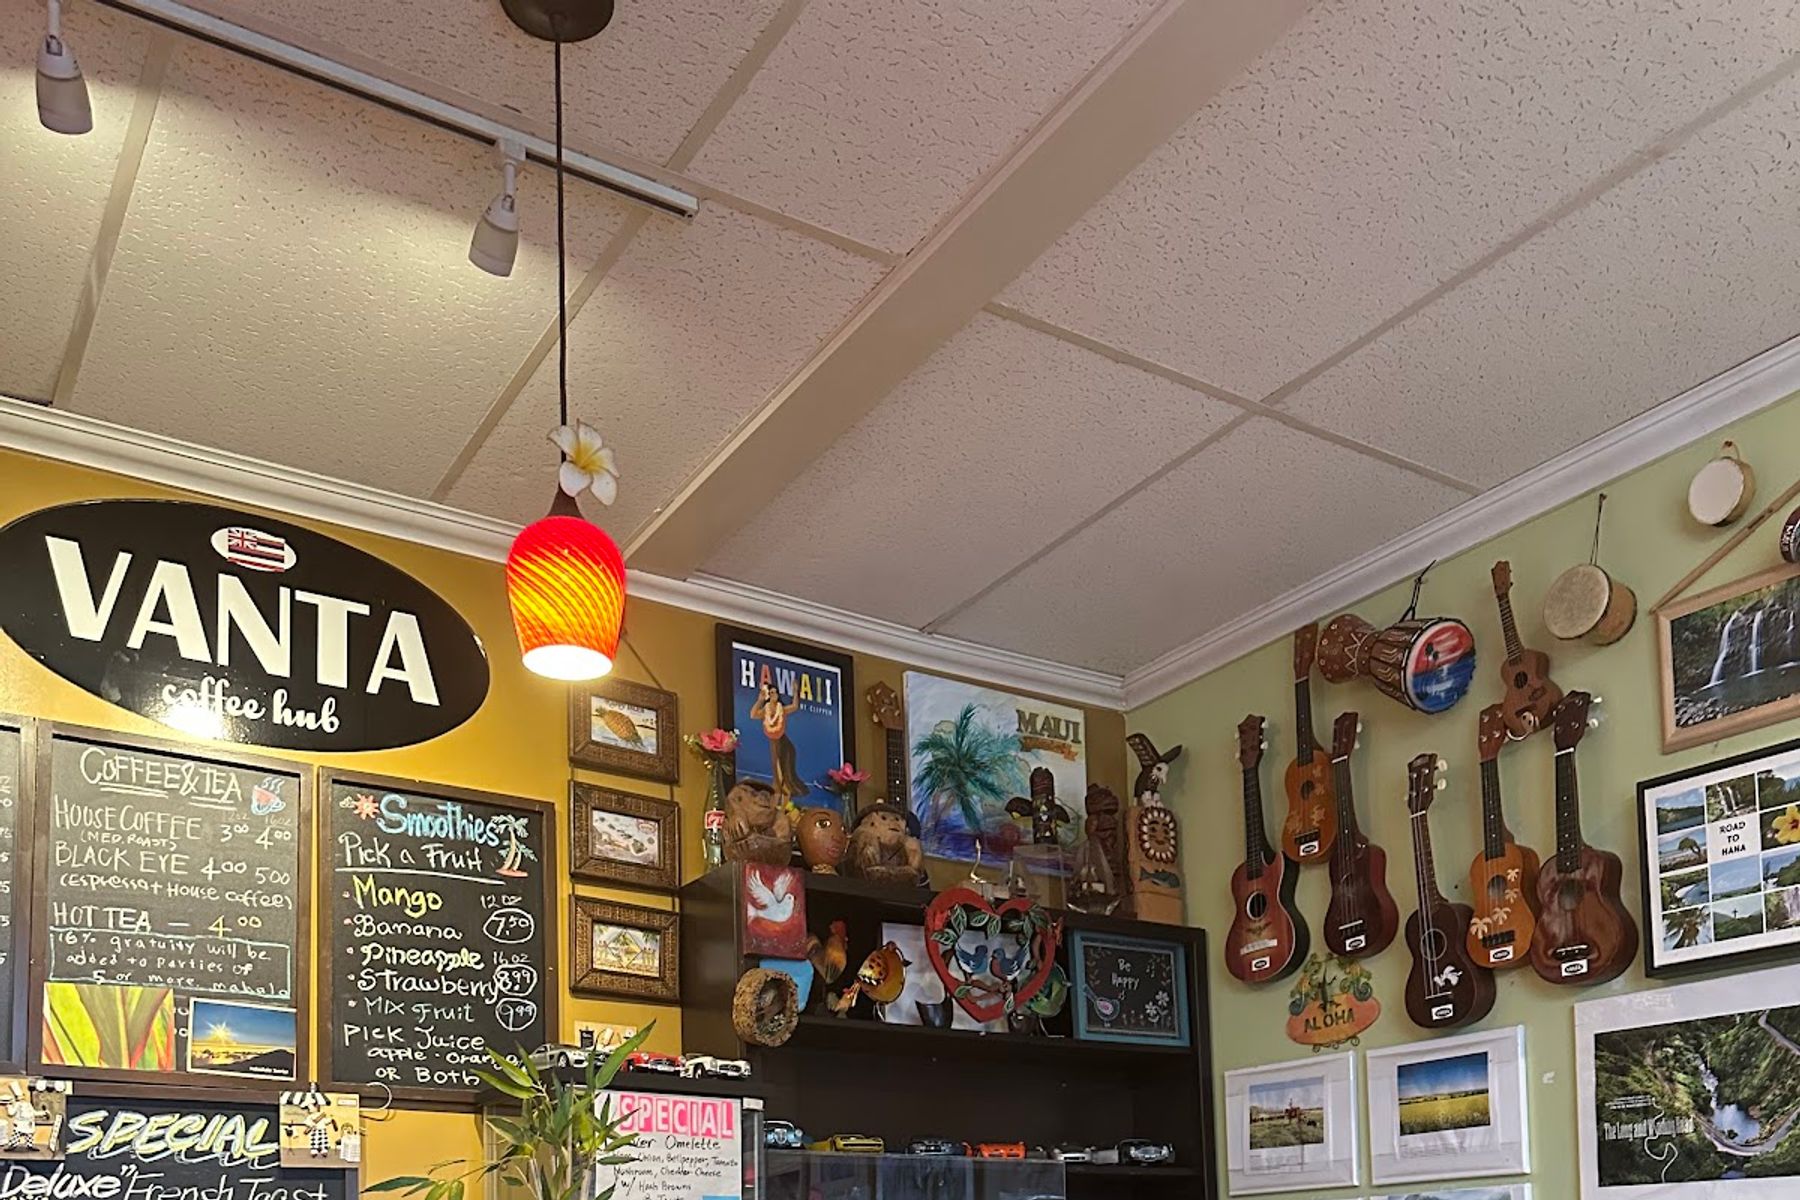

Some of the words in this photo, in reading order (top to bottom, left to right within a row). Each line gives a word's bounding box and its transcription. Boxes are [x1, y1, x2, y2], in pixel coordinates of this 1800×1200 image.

[45, 535, 440, 706] VANTA
[741, 658, 832, 706] HAWAII
[162, 676, 266, 722] coffee
[273, 689, 340, 734] hub
[1016, 709, 1082, 744] MAUI
[54, 794, 117, 831] HOUSE
[119, 804, 202, 841] COFFEE
[376, 793, 501, 847] Smoothies
[1719, 821, 1746, 834] ROAD
[1721, 844, 1746, 856] HANA
[1727, 834, 1740, 843] TO
[55, 840, 131, 872] BLACK
[139, 850, 190, 876] EYE
[399, 848, 416, 865] a
[421, 842, 483, 873] Fruit
[352, 874, 443, 918] Mango
[53, 902, 99, 929] HOT
[103, 907, 152, 933] TEA
[353, 913, 463, 940] Banana
[58, 931, 97, 945] 16%
[110, 935, 196, 954] gratuity
[207, 942, 237, 959] will
[66, 945, 118, 965] added
[126, 956, 147, 968] to
[232, 963, 253, 976] of
[360, 942, 485, 973] Pineapple
[93, 969, 107, 985] 5
[116, 972, 132, 981] or
[357, 967, 499, 1005] Strawberry
[411, 1003, 475, 1024] Fruit
[1303, 1008, 1355, 1033] ALOHA
[414, 1025, 486, 1051] Juice
[367, 1046, 428, 1062] apple
[620, 1094, 735, 1139] SPECIAL
[65, 1109, 281, 1166] SPECIAL
[665, 1134, 721, 1150] Omelette
